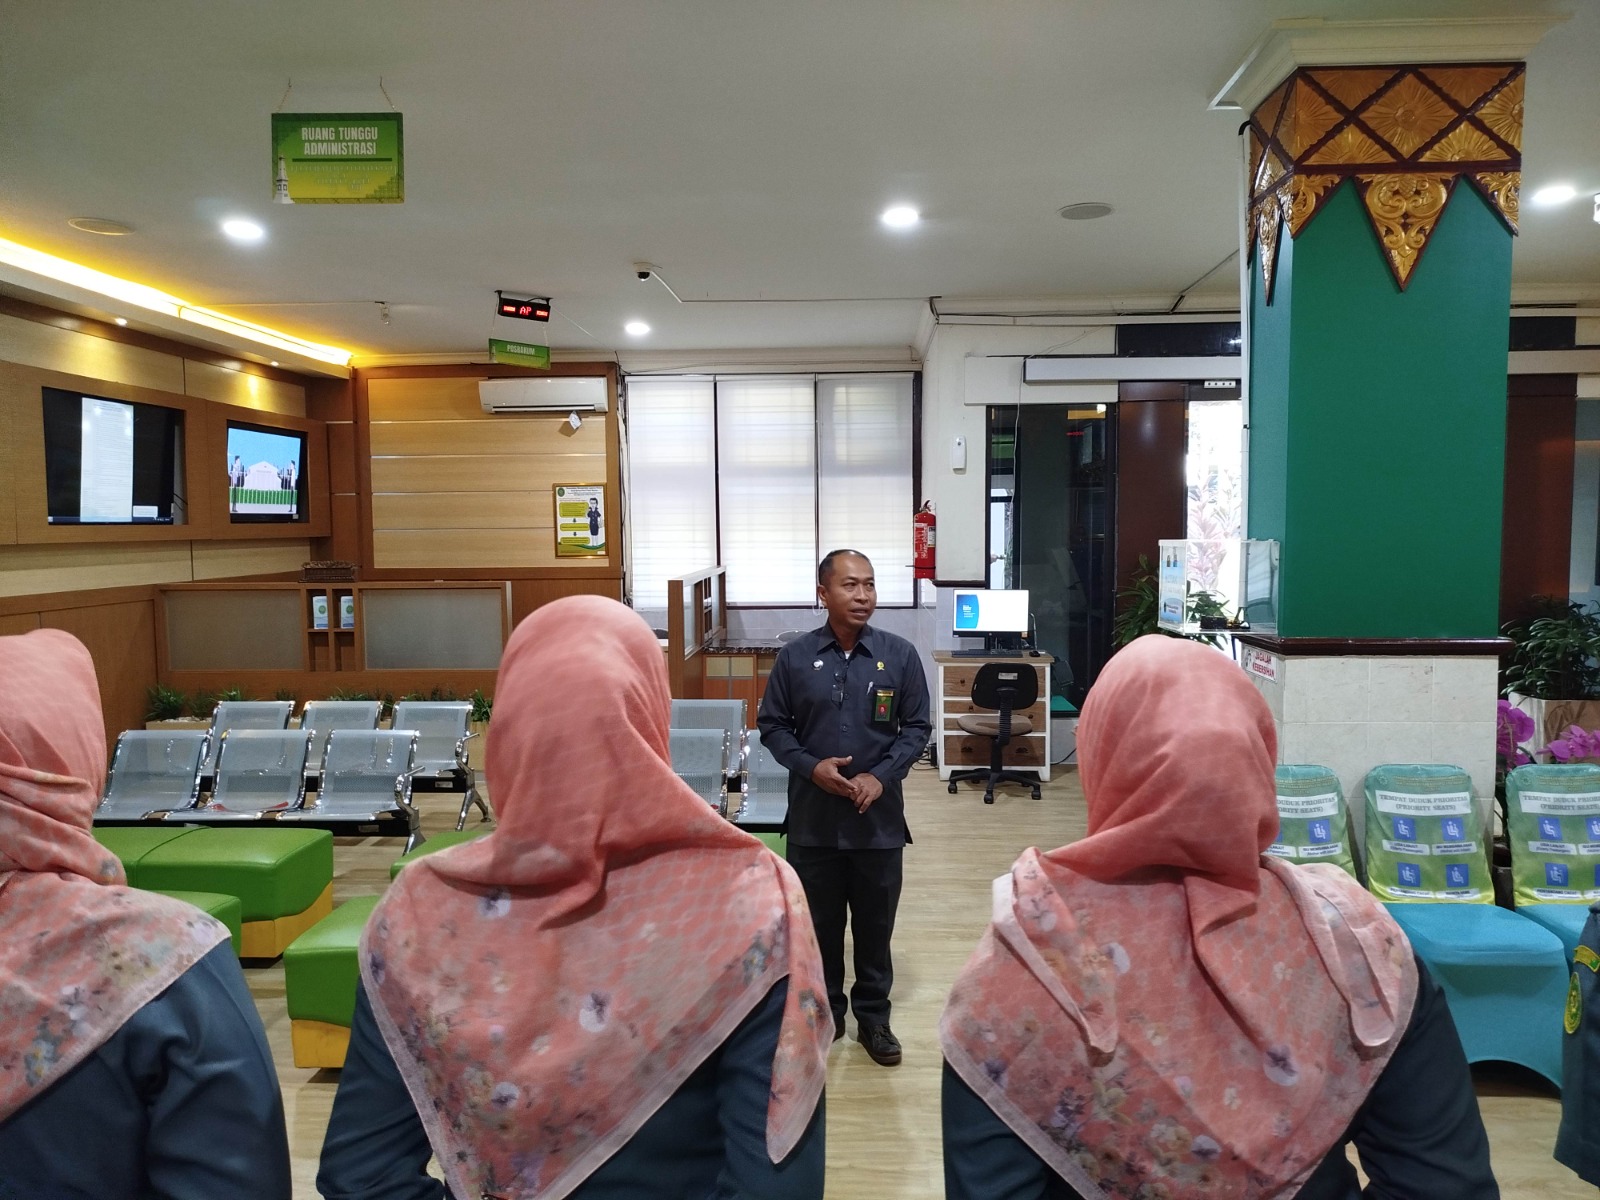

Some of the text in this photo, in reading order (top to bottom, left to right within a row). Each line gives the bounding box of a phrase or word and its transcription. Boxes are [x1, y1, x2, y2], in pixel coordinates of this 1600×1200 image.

[301, 127, 378, 141] RUANG TUNGGU
[303, 142, 377, 156] ADMINISTRASI
